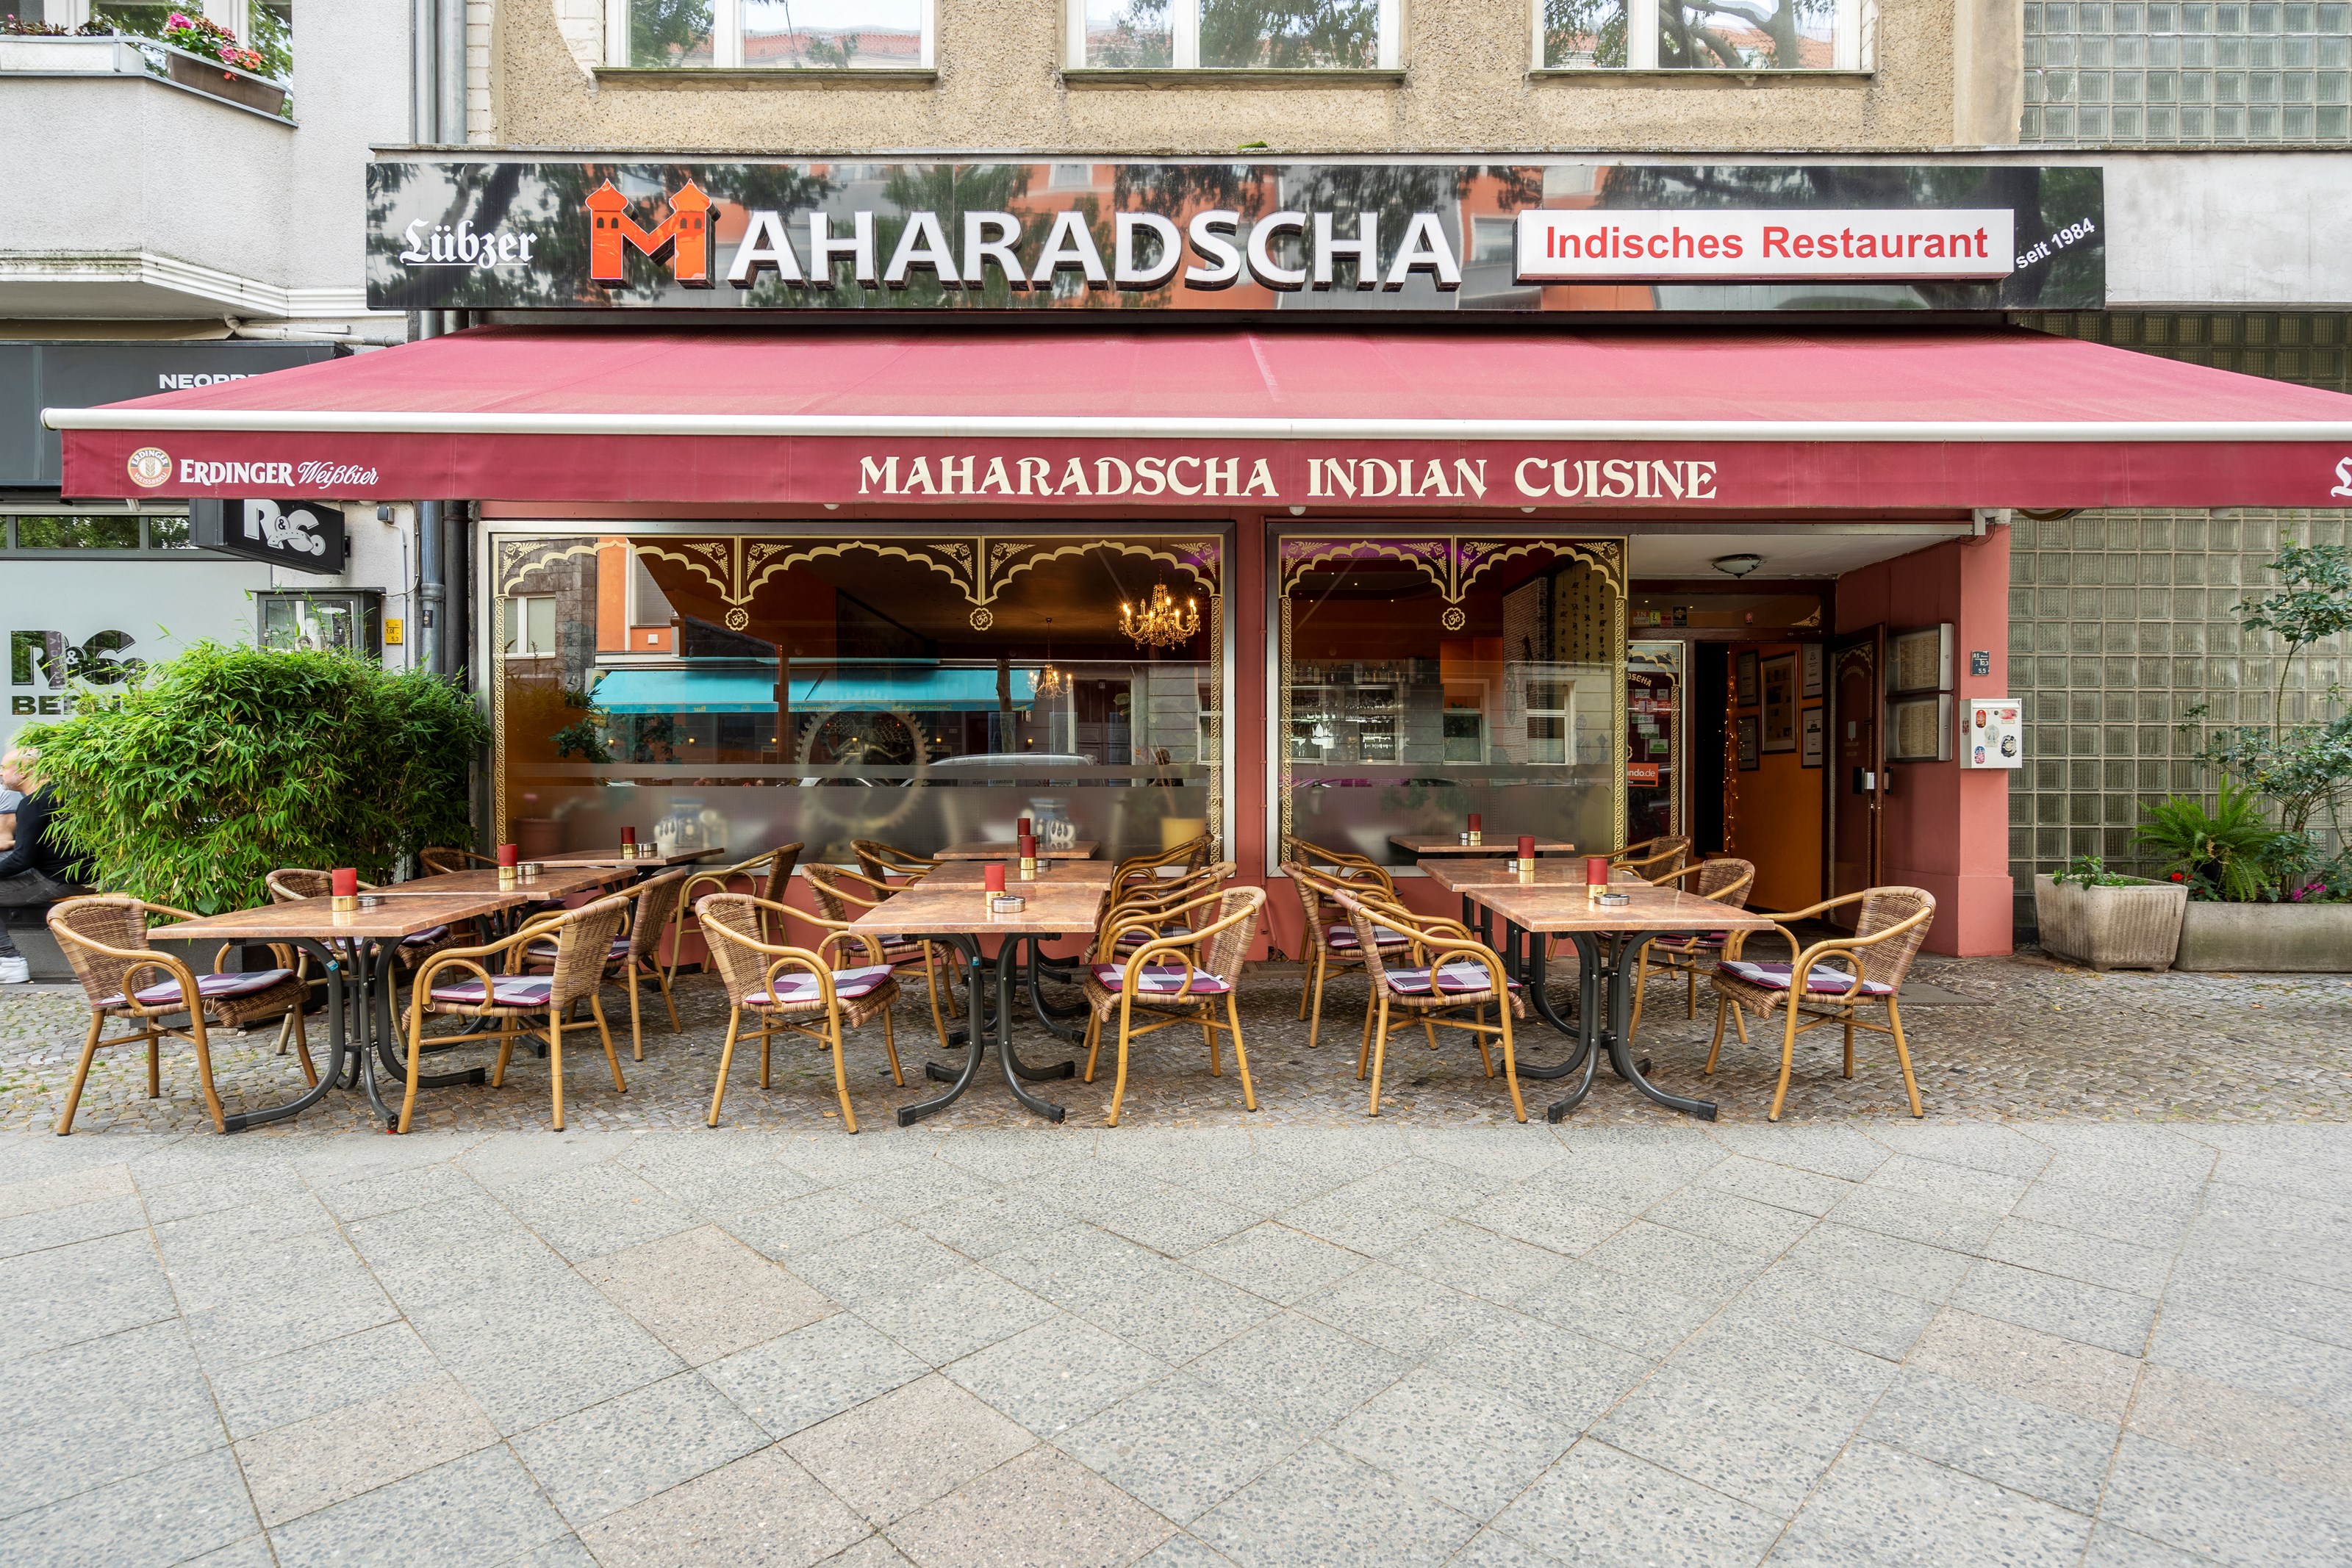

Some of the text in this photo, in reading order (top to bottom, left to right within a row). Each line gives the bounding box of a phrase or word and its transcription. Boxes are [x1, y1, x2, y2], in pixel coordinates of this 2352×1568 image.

[399, 217, 538, 269] Lübzer
[1546, 226, 1988, 259] Indisches Restaurant
[2015, 217, 2095, 269] seit 1984
[131, 450, 168, 466] ERDINGER
[179, 458, 379, 490] ERDINGER Weißbier
[858, 456, 1718, 500] MAHARADSCHA INDIAN CUISINE
